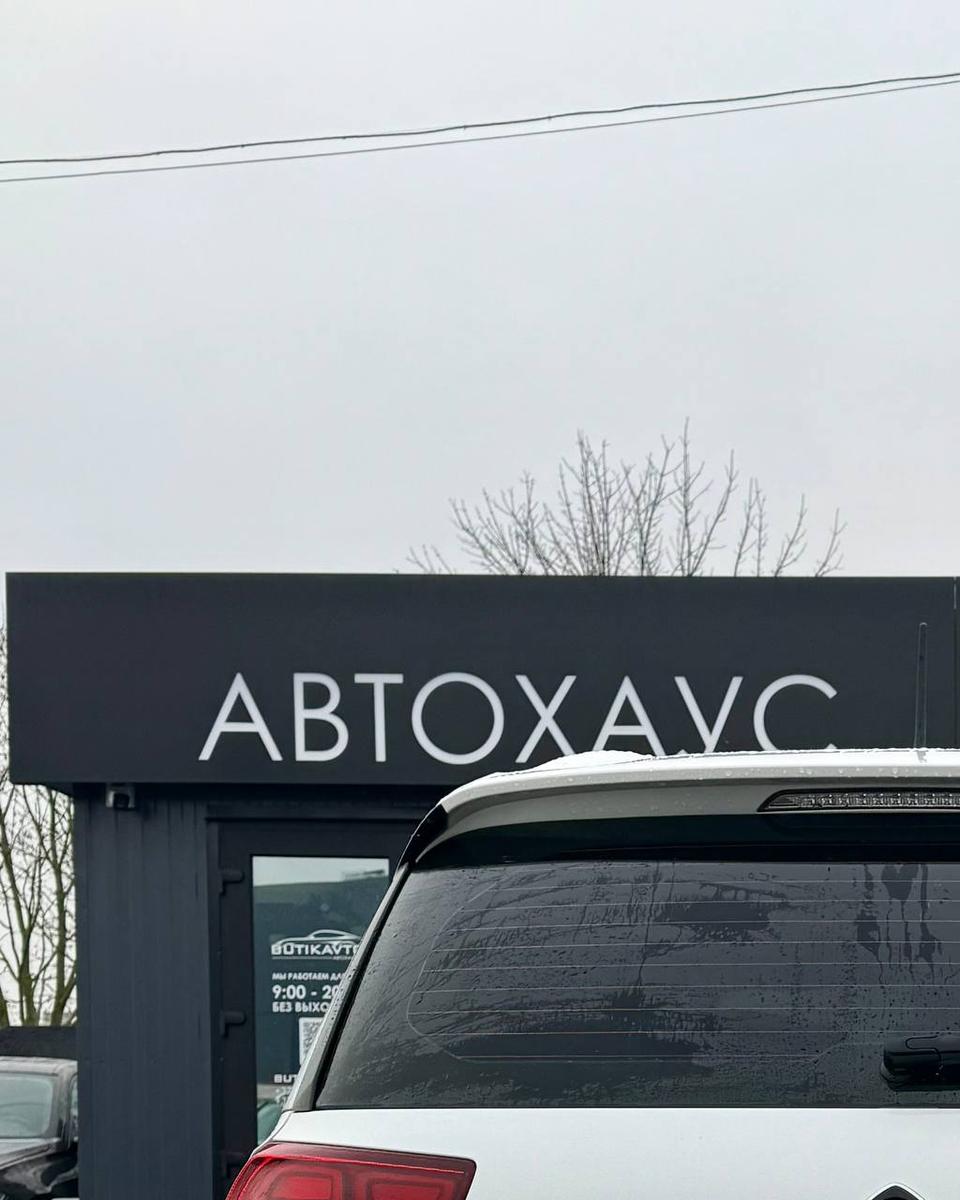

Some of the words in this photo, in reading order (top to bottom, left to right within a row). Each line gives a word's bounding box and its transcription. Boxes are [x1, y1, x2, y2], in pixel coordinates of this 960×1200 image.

[198, 672, 838, 765] АВТОХАУС
[288, 972, 330, 981] РАБОТАЕМ
[330, 972, 344, 981] ДЛ
[272, 984, 307, 1000] 9:00
[322, 984, 341, 1000] 20
[272, 1001, 293, 1013] БЕЗ
[294, 1001, 331, 1013] ВЫХО
[273, 1073, 298, 1084] BUT
